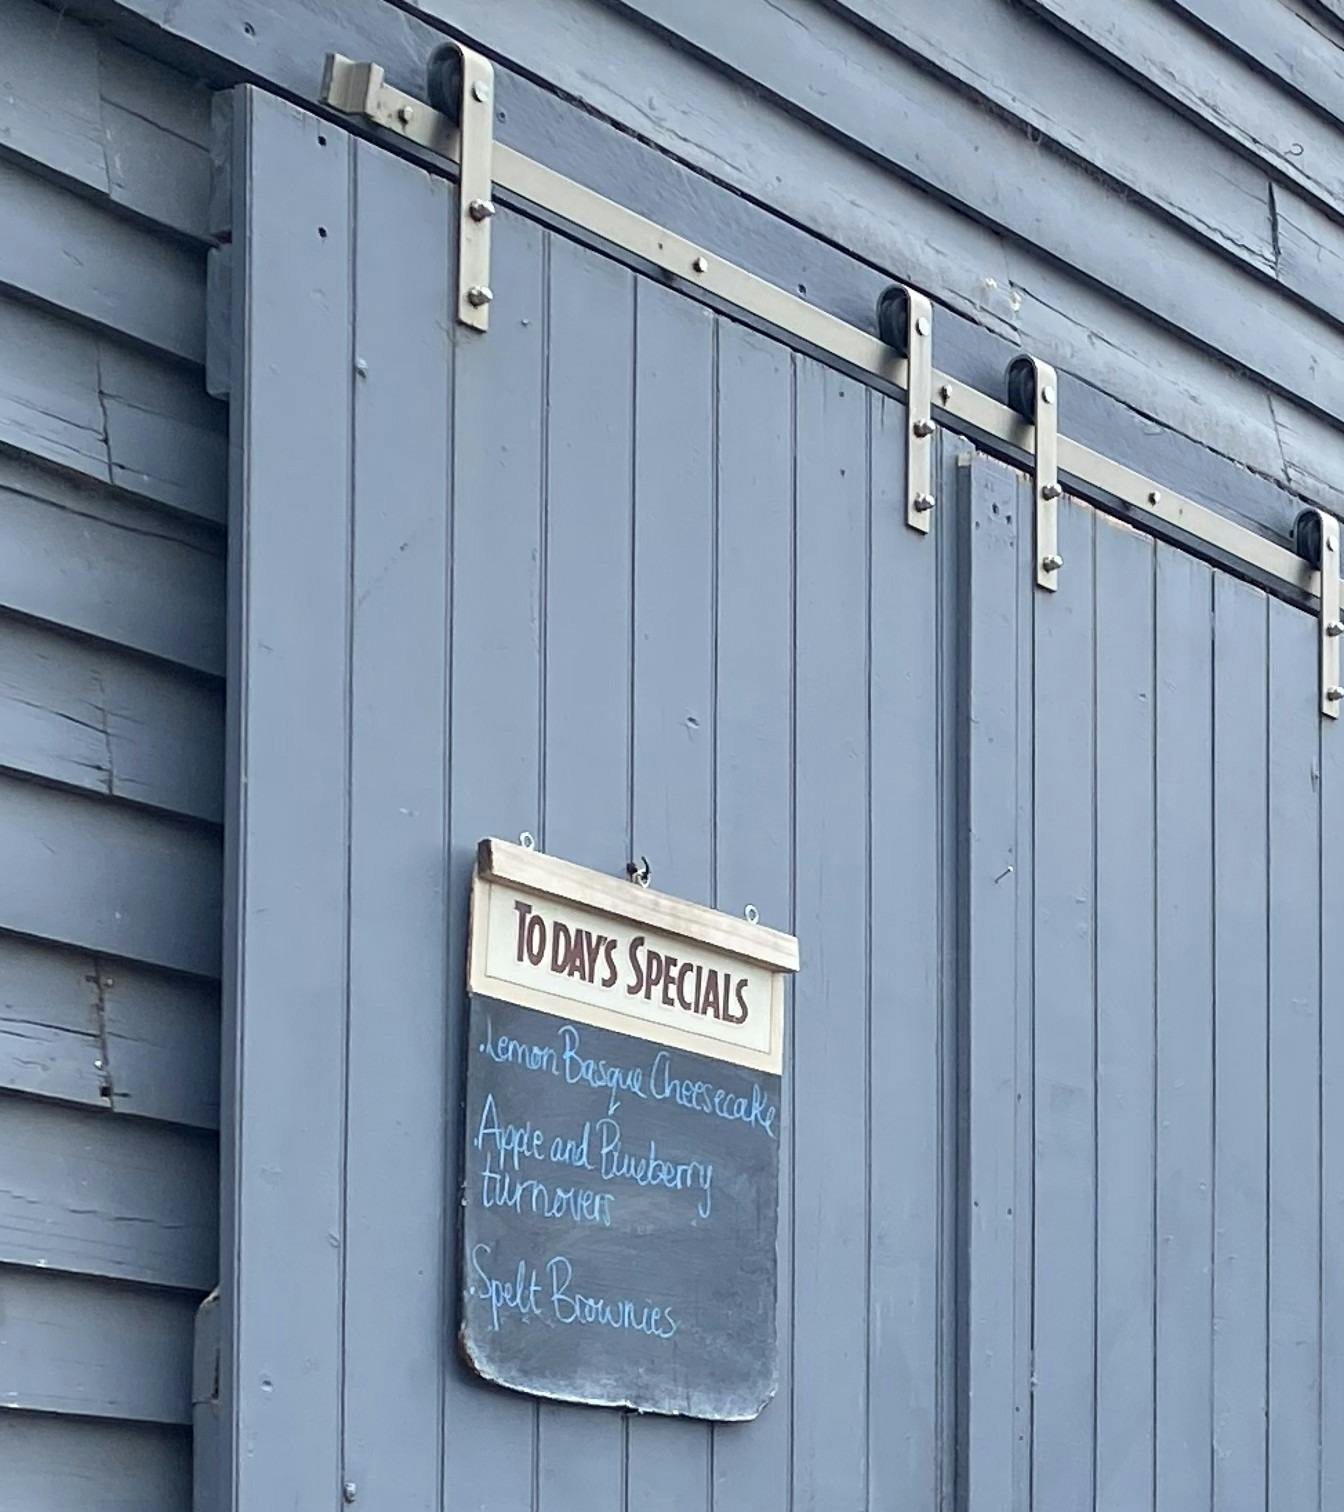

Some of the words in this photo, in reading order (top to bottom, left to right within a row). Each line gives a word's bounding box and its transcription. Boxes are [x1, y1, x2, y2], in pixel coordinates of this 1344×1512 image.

[626, 935, 749, 1025] SPECIALS
[486, 1015, 560, 1077] Lemon
[557, 1024, 648, 1117] Basque
[478, 1092, 545, 1171] Apple
[550, 1120, 595, 1171] and
[471, 1242, 543, 1332] Spelt
[546, 1255, 678, 1339] Brownies
